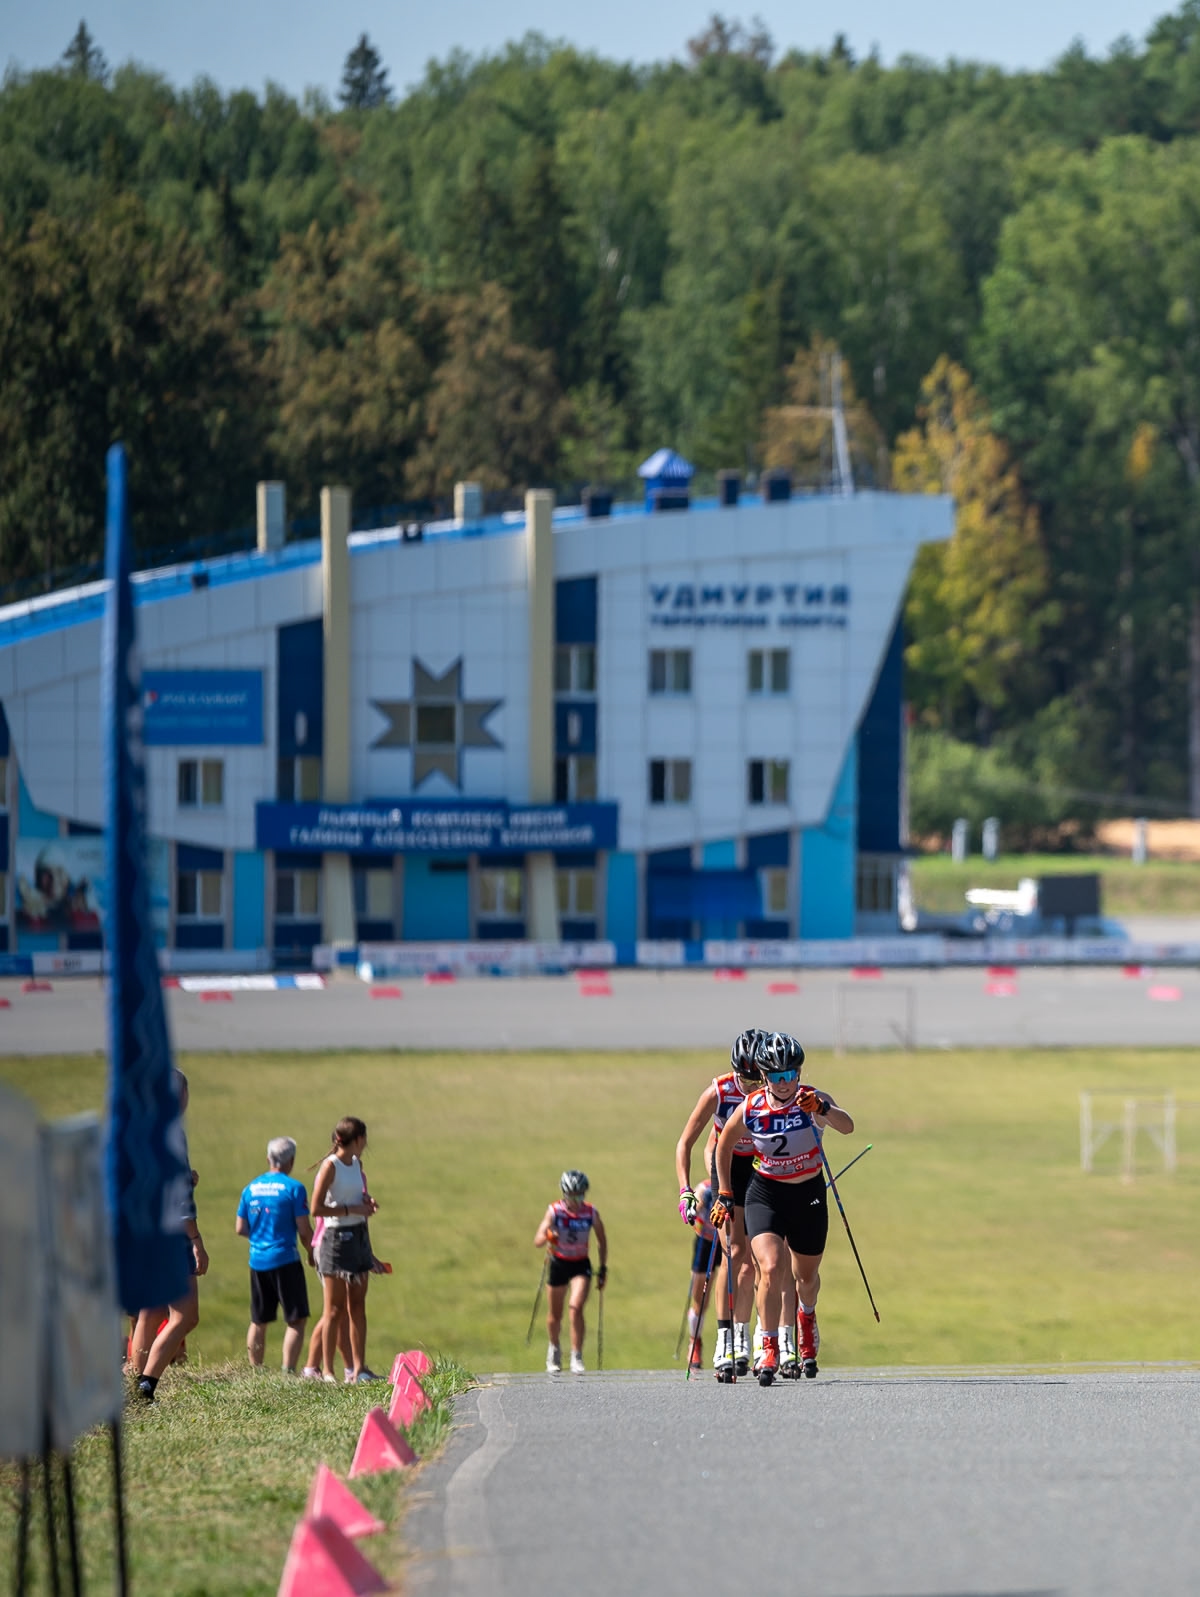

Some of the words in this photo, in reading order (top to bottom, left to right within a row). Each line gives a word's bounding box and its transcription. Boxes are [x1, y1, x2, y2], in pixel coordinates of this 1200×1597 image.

[650, 583, 850, 610] УДМУРТИЯ
[411, 809, 504, 827] КОМПЛЕКС
[770, 1134, 791, 1157] 2
